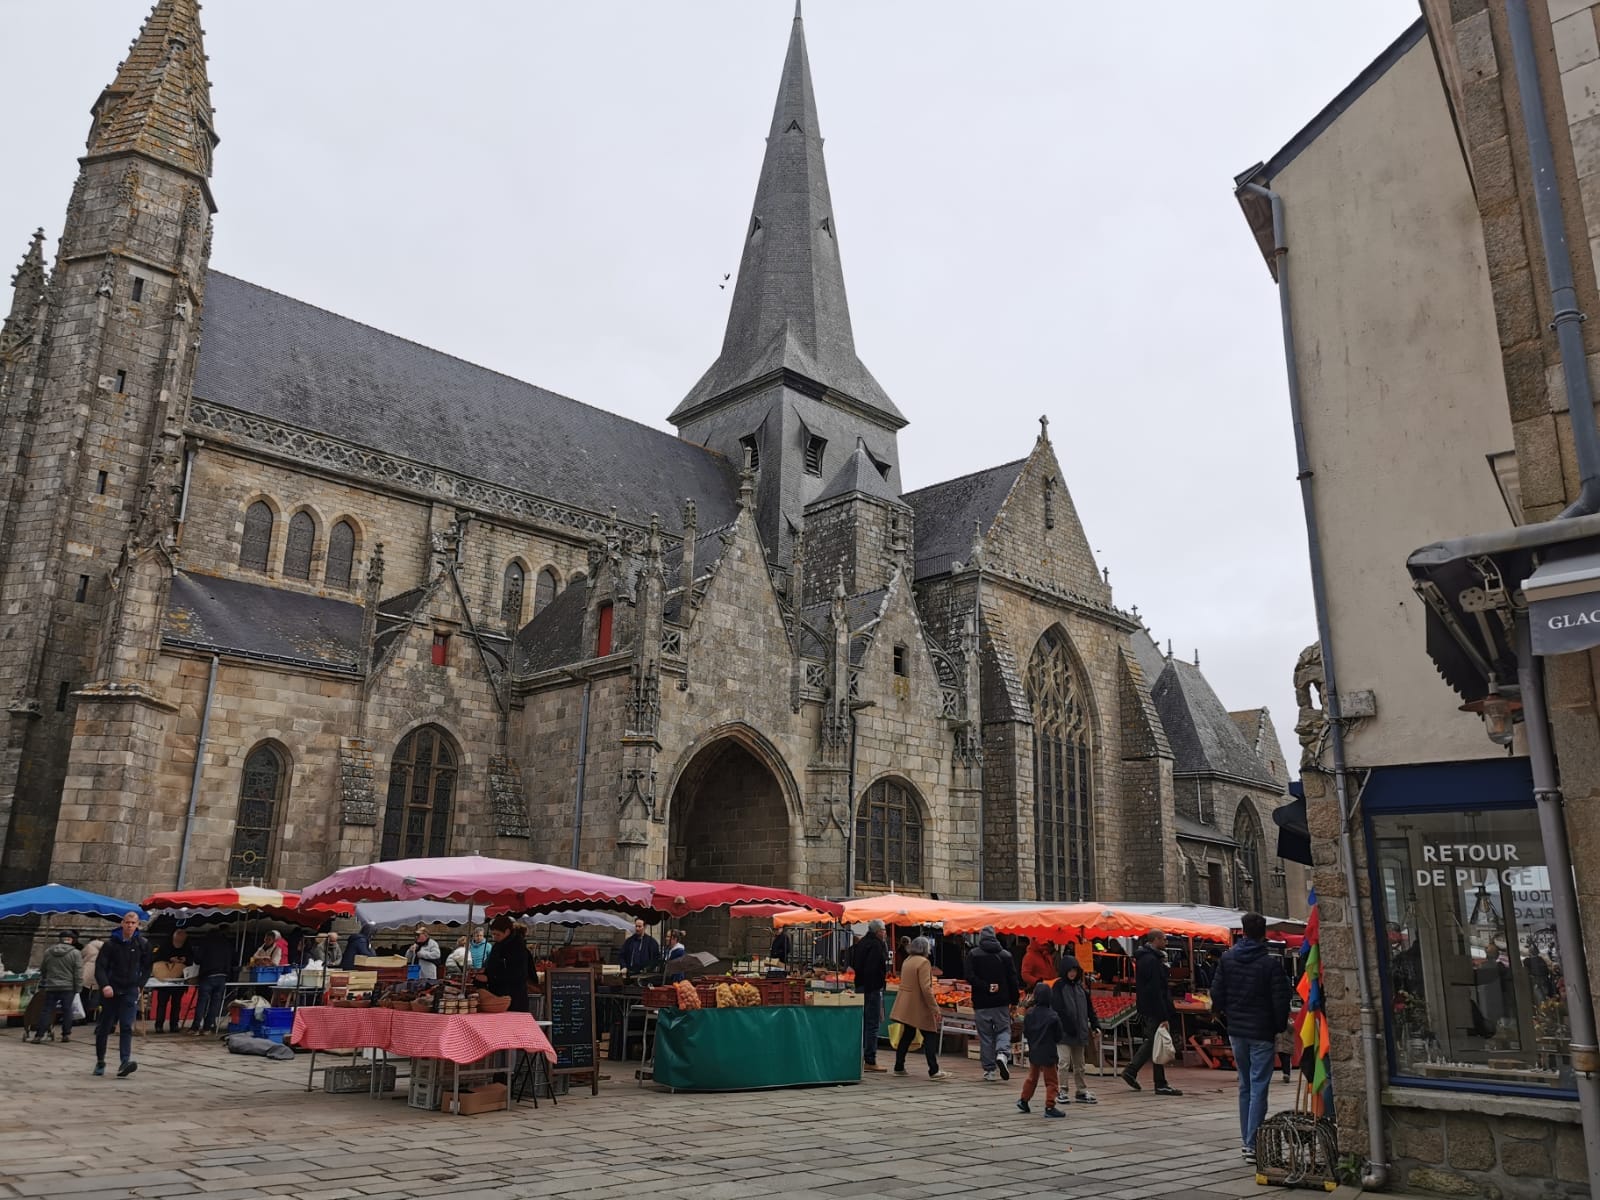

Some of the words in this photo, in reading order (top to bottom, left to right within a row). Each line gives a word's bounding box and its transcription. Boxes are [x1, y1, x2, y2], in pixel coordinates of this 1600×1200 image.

[1548, 609, 1600, 630] GLAC
[1423, 844, 1519, 862] RETOUR
[1416, 869, 1446, 887] DE
[1455, 868, 1533, 887] PLAGE
